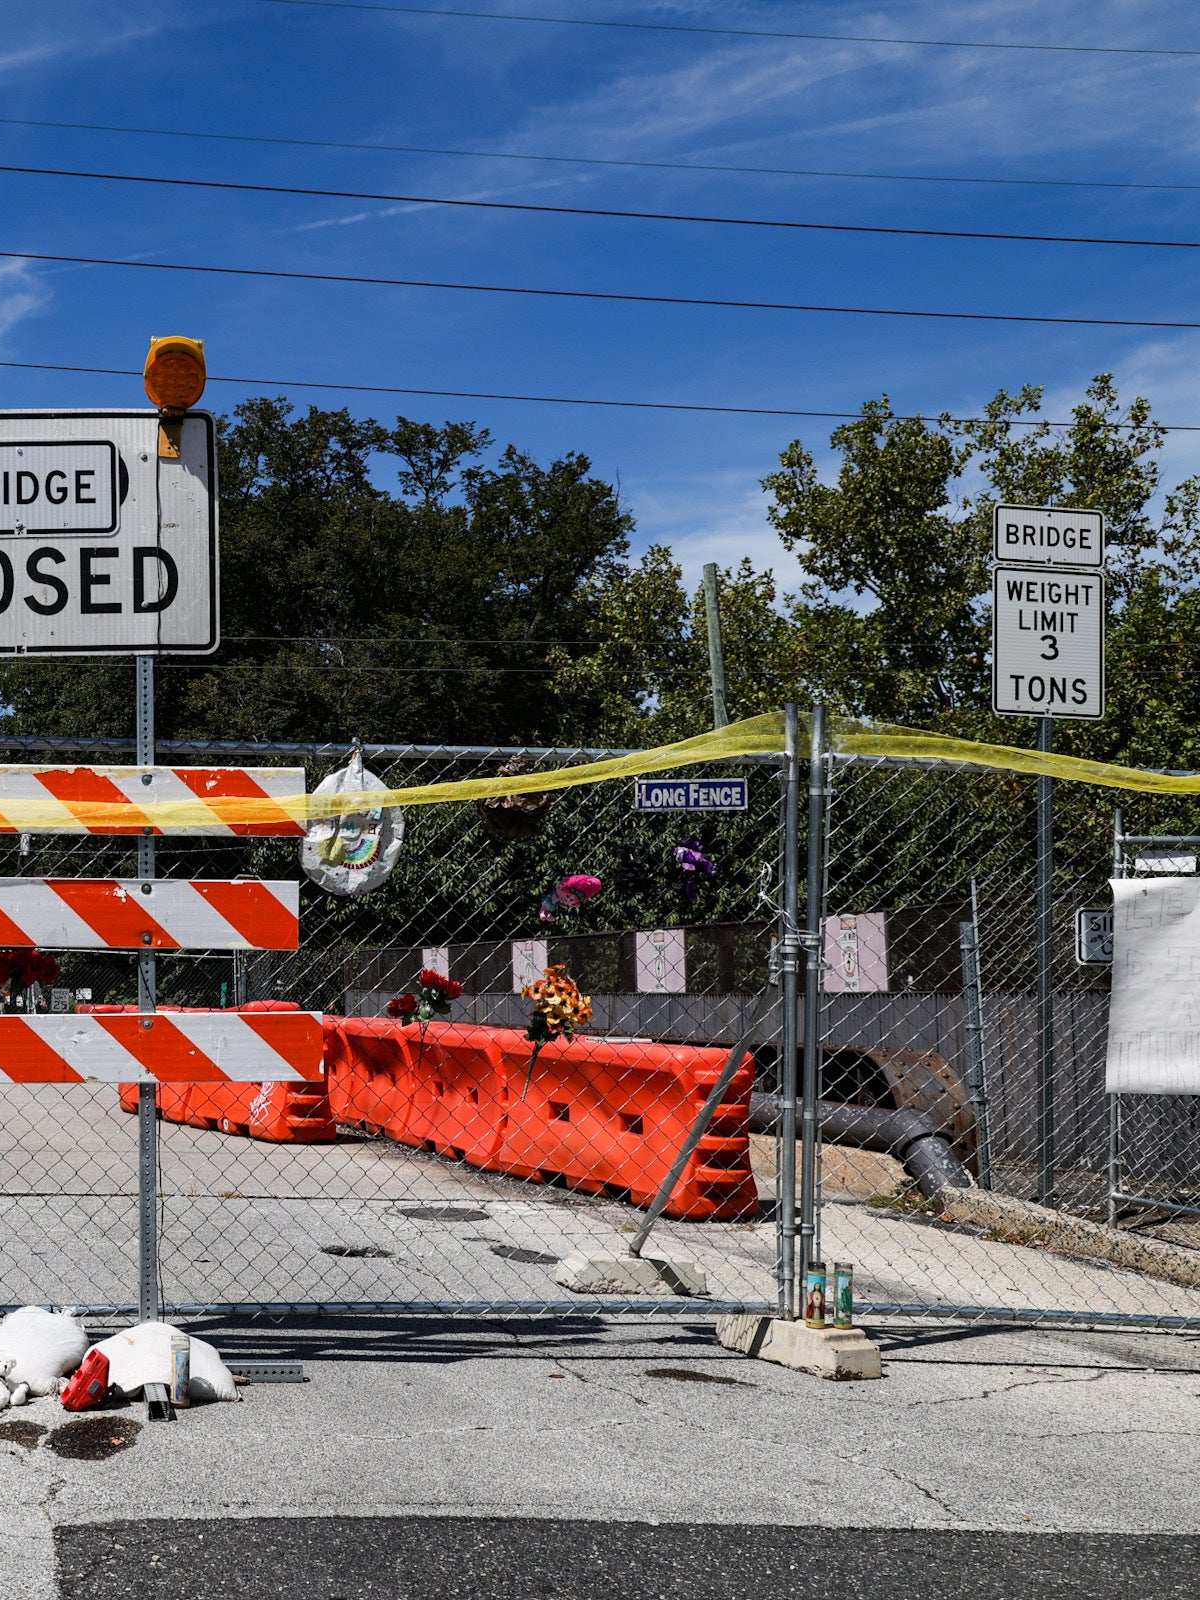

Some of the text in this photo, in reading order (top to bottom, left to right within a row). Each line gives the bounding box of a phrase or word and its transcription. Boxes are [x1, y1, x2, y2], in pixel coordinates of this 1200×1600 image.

[1006, 523, 1092, 550] BRIDGE
[1006, 580, 1093, 606] WEIGHT
[1019, 610, 1079, 633] LIMIT
[1040, 634, 1060, 661] 3
[1010, 674, 1088, 705] TONS
[641, 783, 742, 807] LONG FENCE
[53, 1001, 67, 1010] 25
